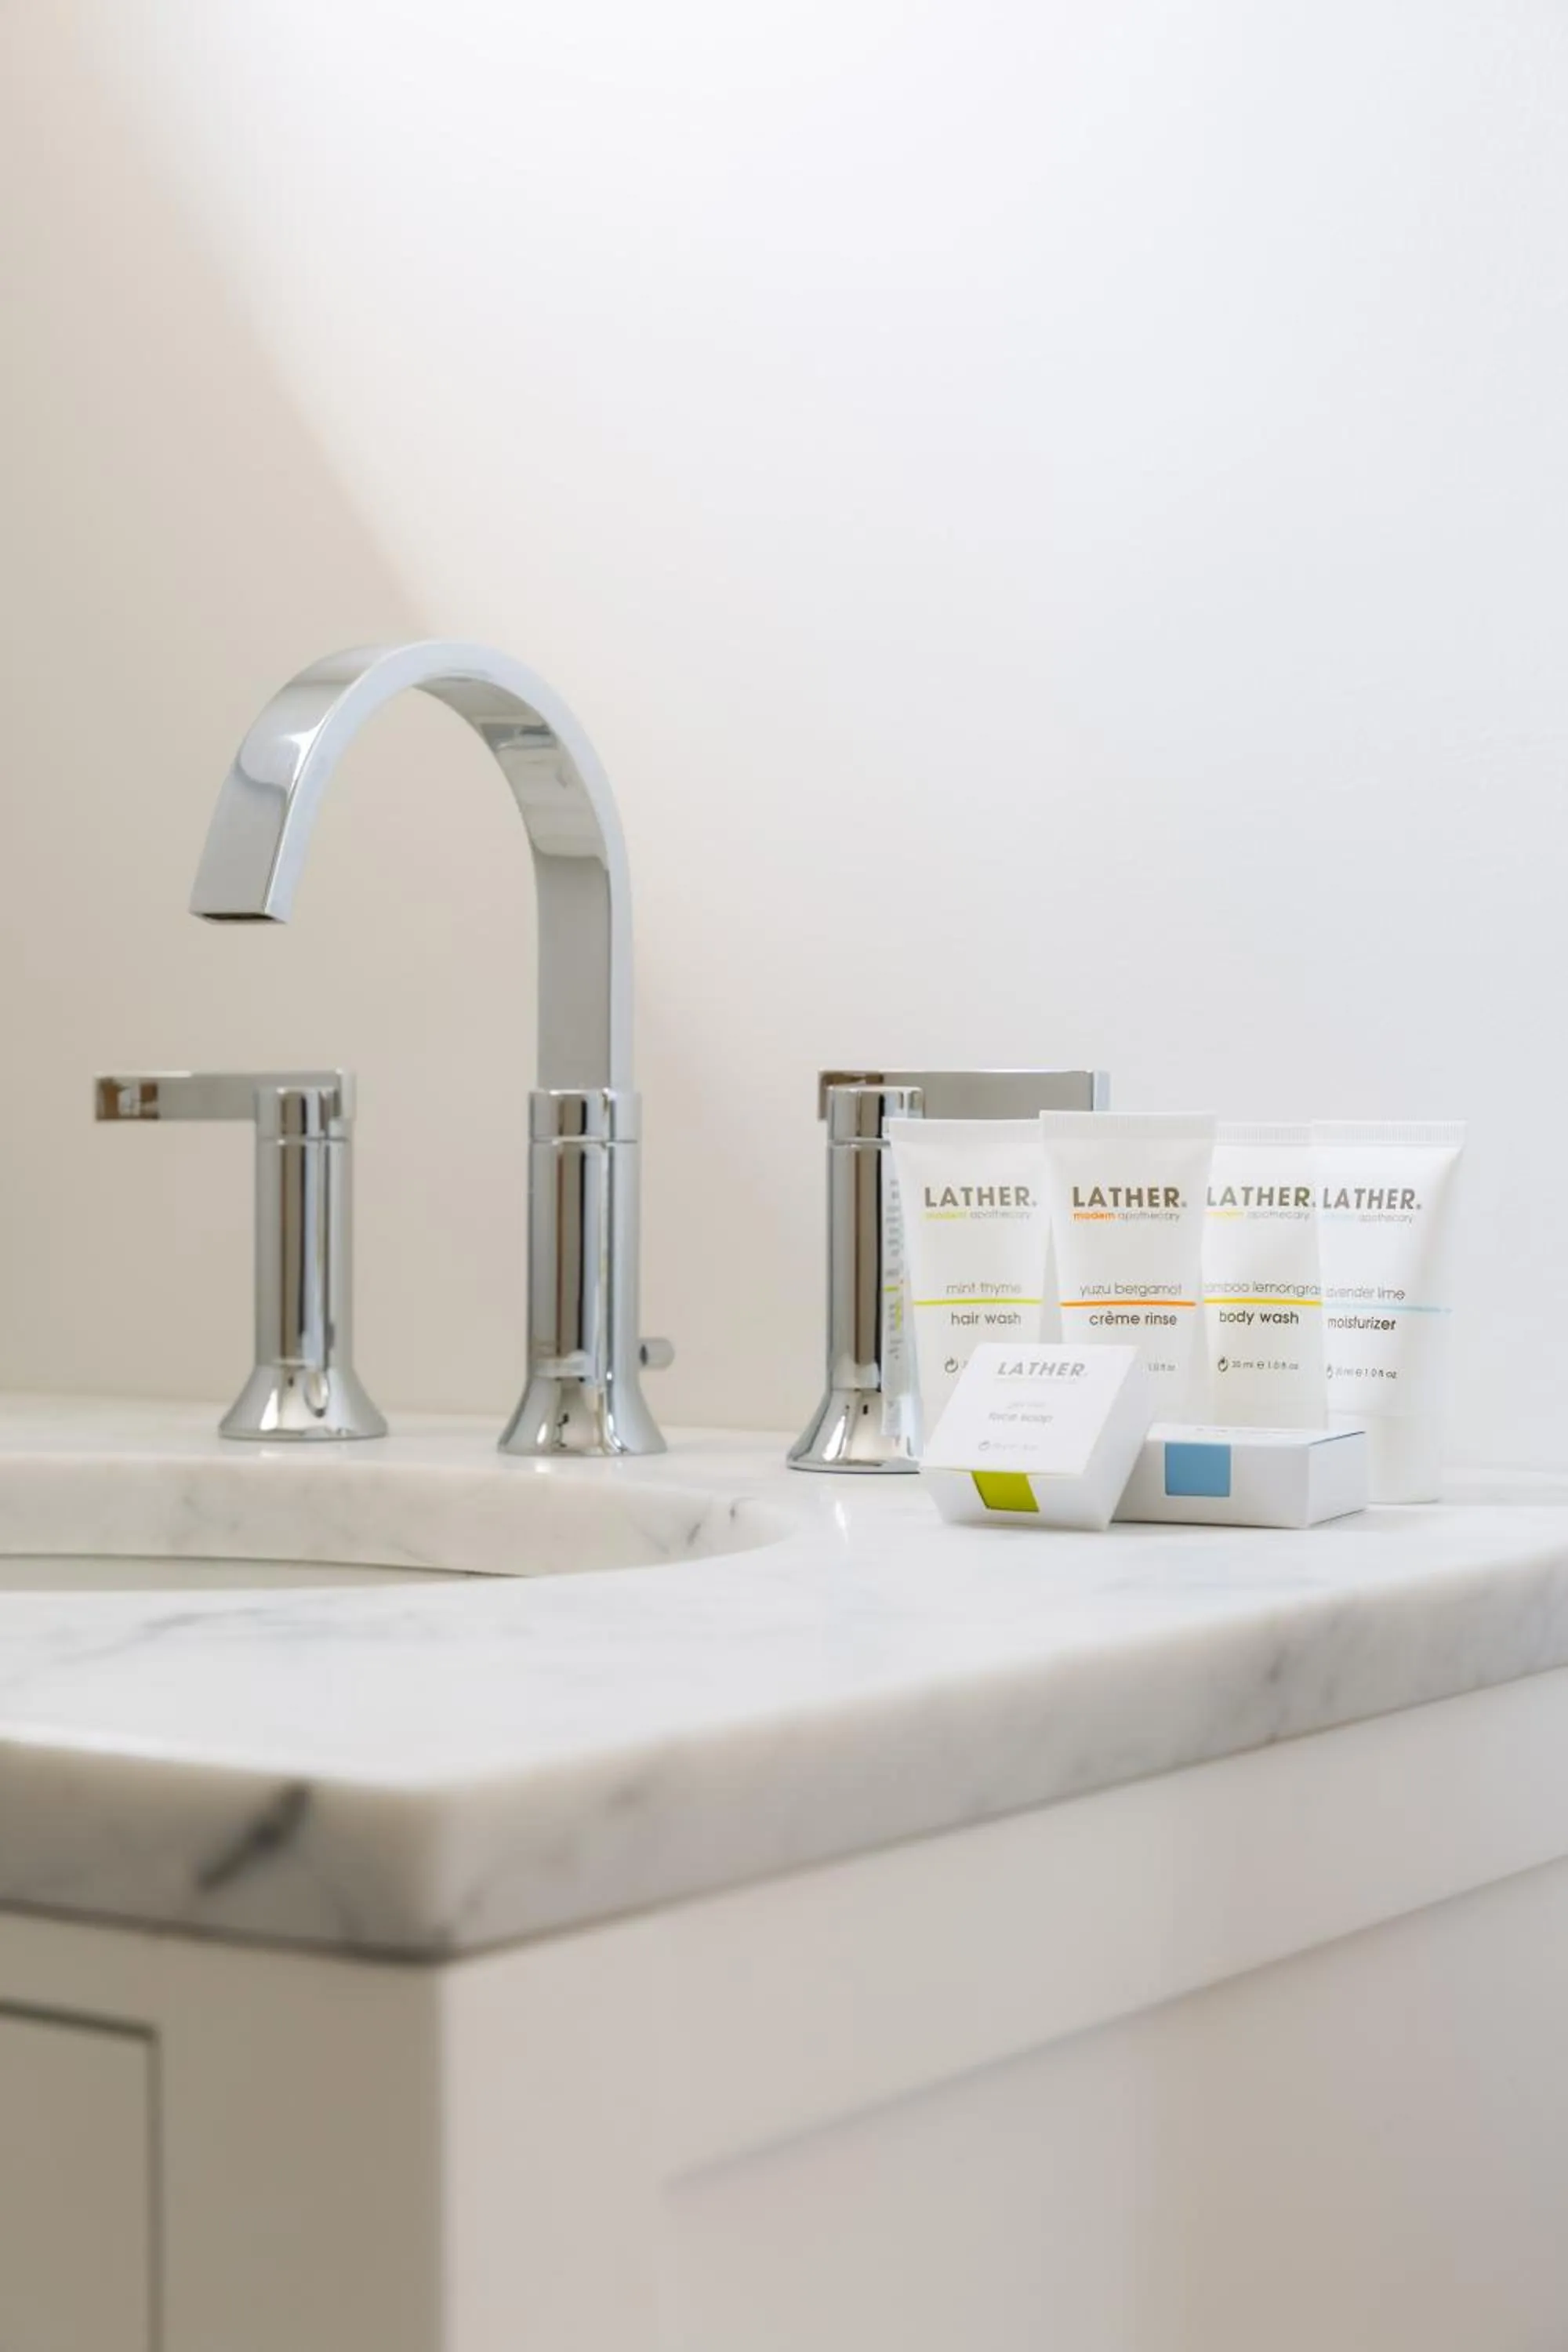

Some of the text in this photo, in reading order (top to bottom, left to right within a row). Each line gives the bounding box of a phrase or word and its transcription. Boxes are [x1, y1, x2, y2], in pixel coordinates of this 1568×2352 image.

[946, 1282, 1022, 1297] mint thyme
[1080, 1282, 1182, 1298] yuzu bergamot
[1203, 1282, 1250, 1294] amboo
[1326, 1286, 1406, 1300] avender lime
[950, 1311, 1022, 1326] hair wash
[1088, 1310, 1178, 1326] crème rinse
[1218, 1310, 1300, 1326] body wash
[1327, 1316, 1396, 1330] moisturizer
